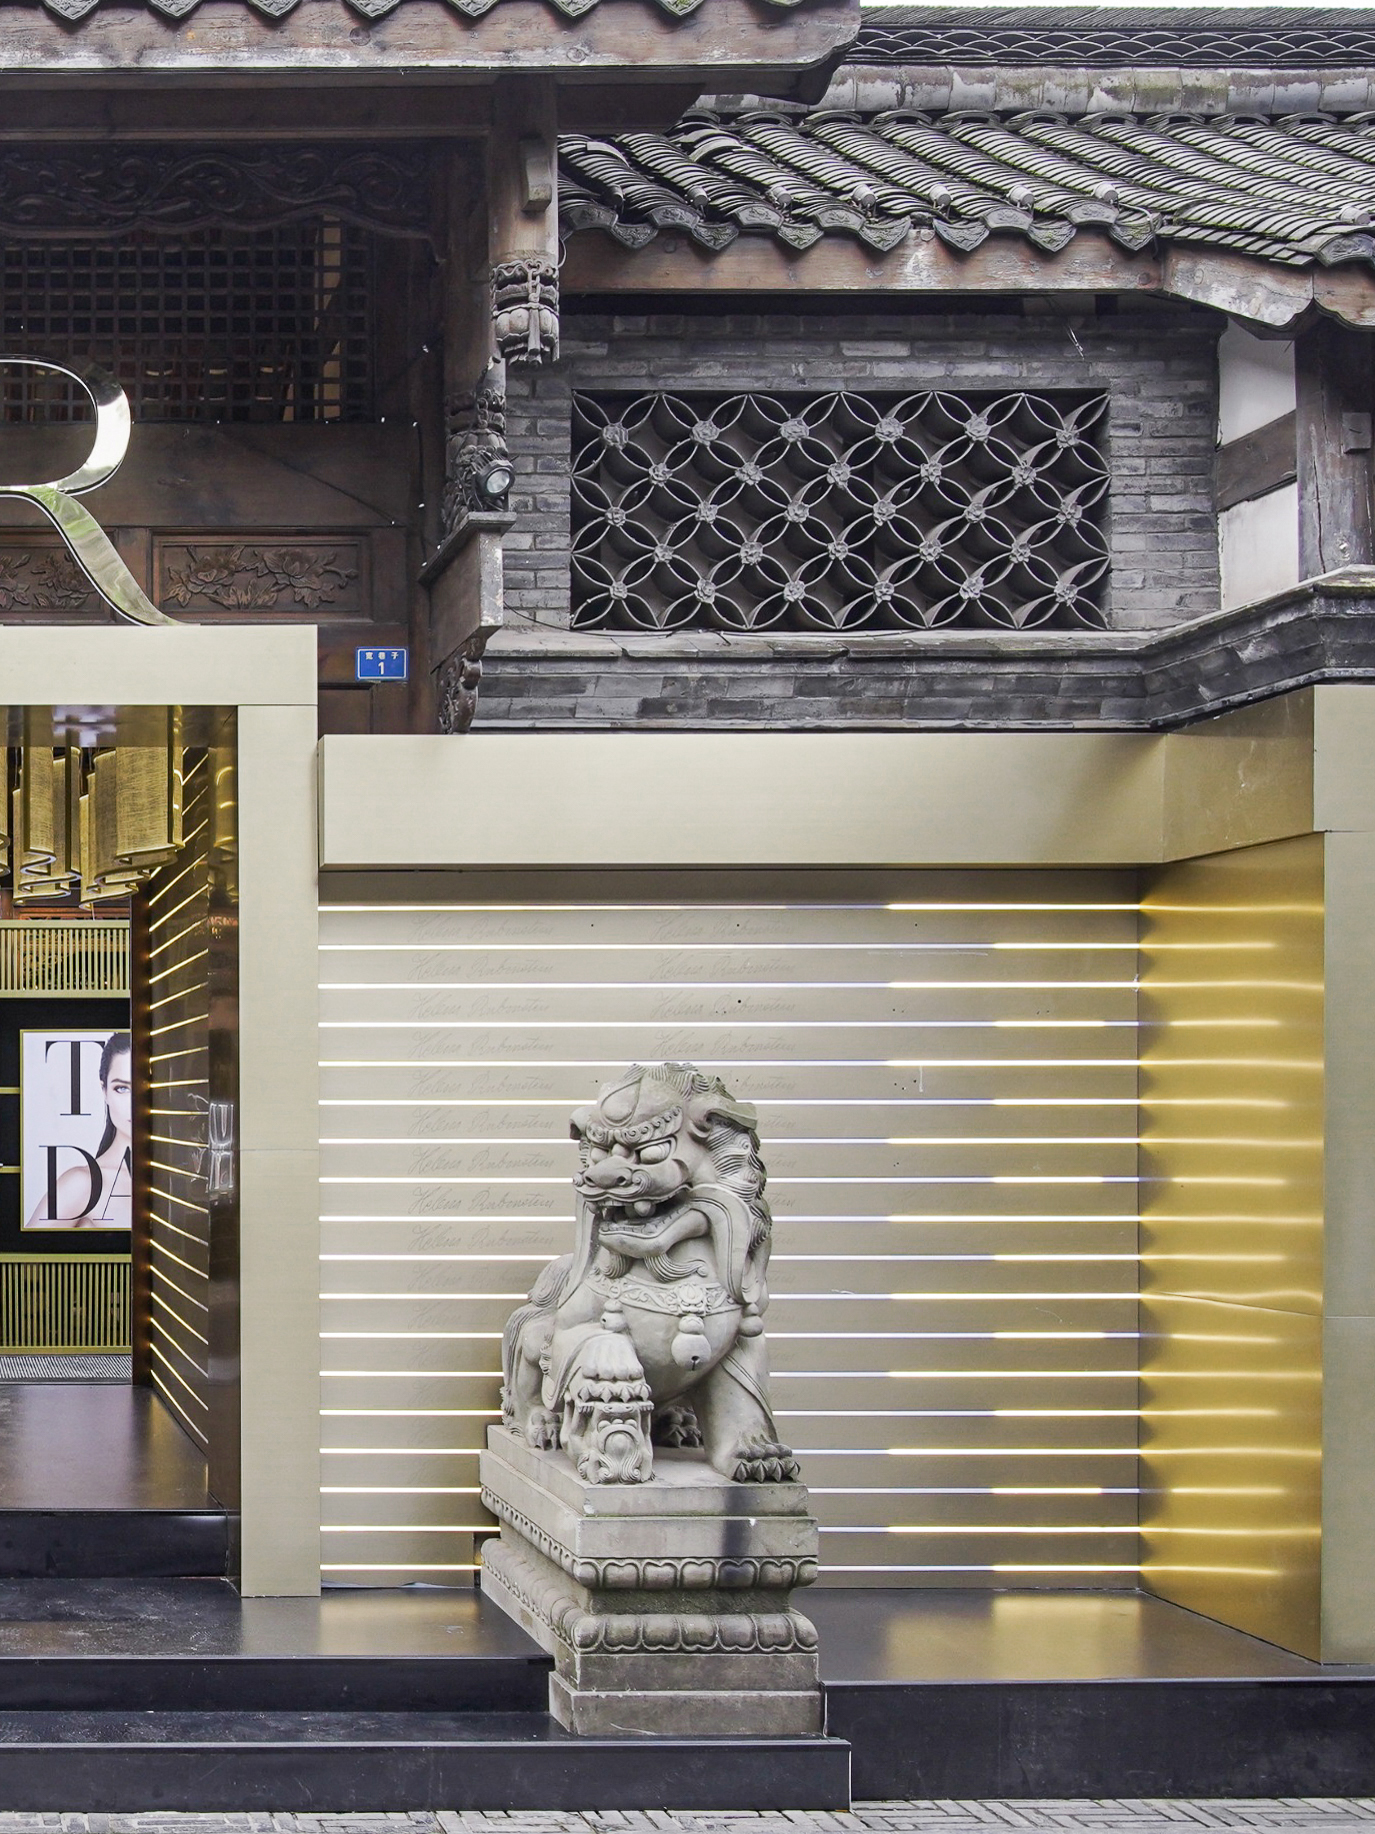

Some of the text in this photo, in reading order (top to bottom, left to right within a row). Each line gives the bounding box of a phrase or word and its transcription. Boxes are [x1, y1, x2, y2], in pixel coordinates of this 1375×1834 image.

[365, 651, 399, 660] 宽巷子
[378, 661, 384, 675] 1
